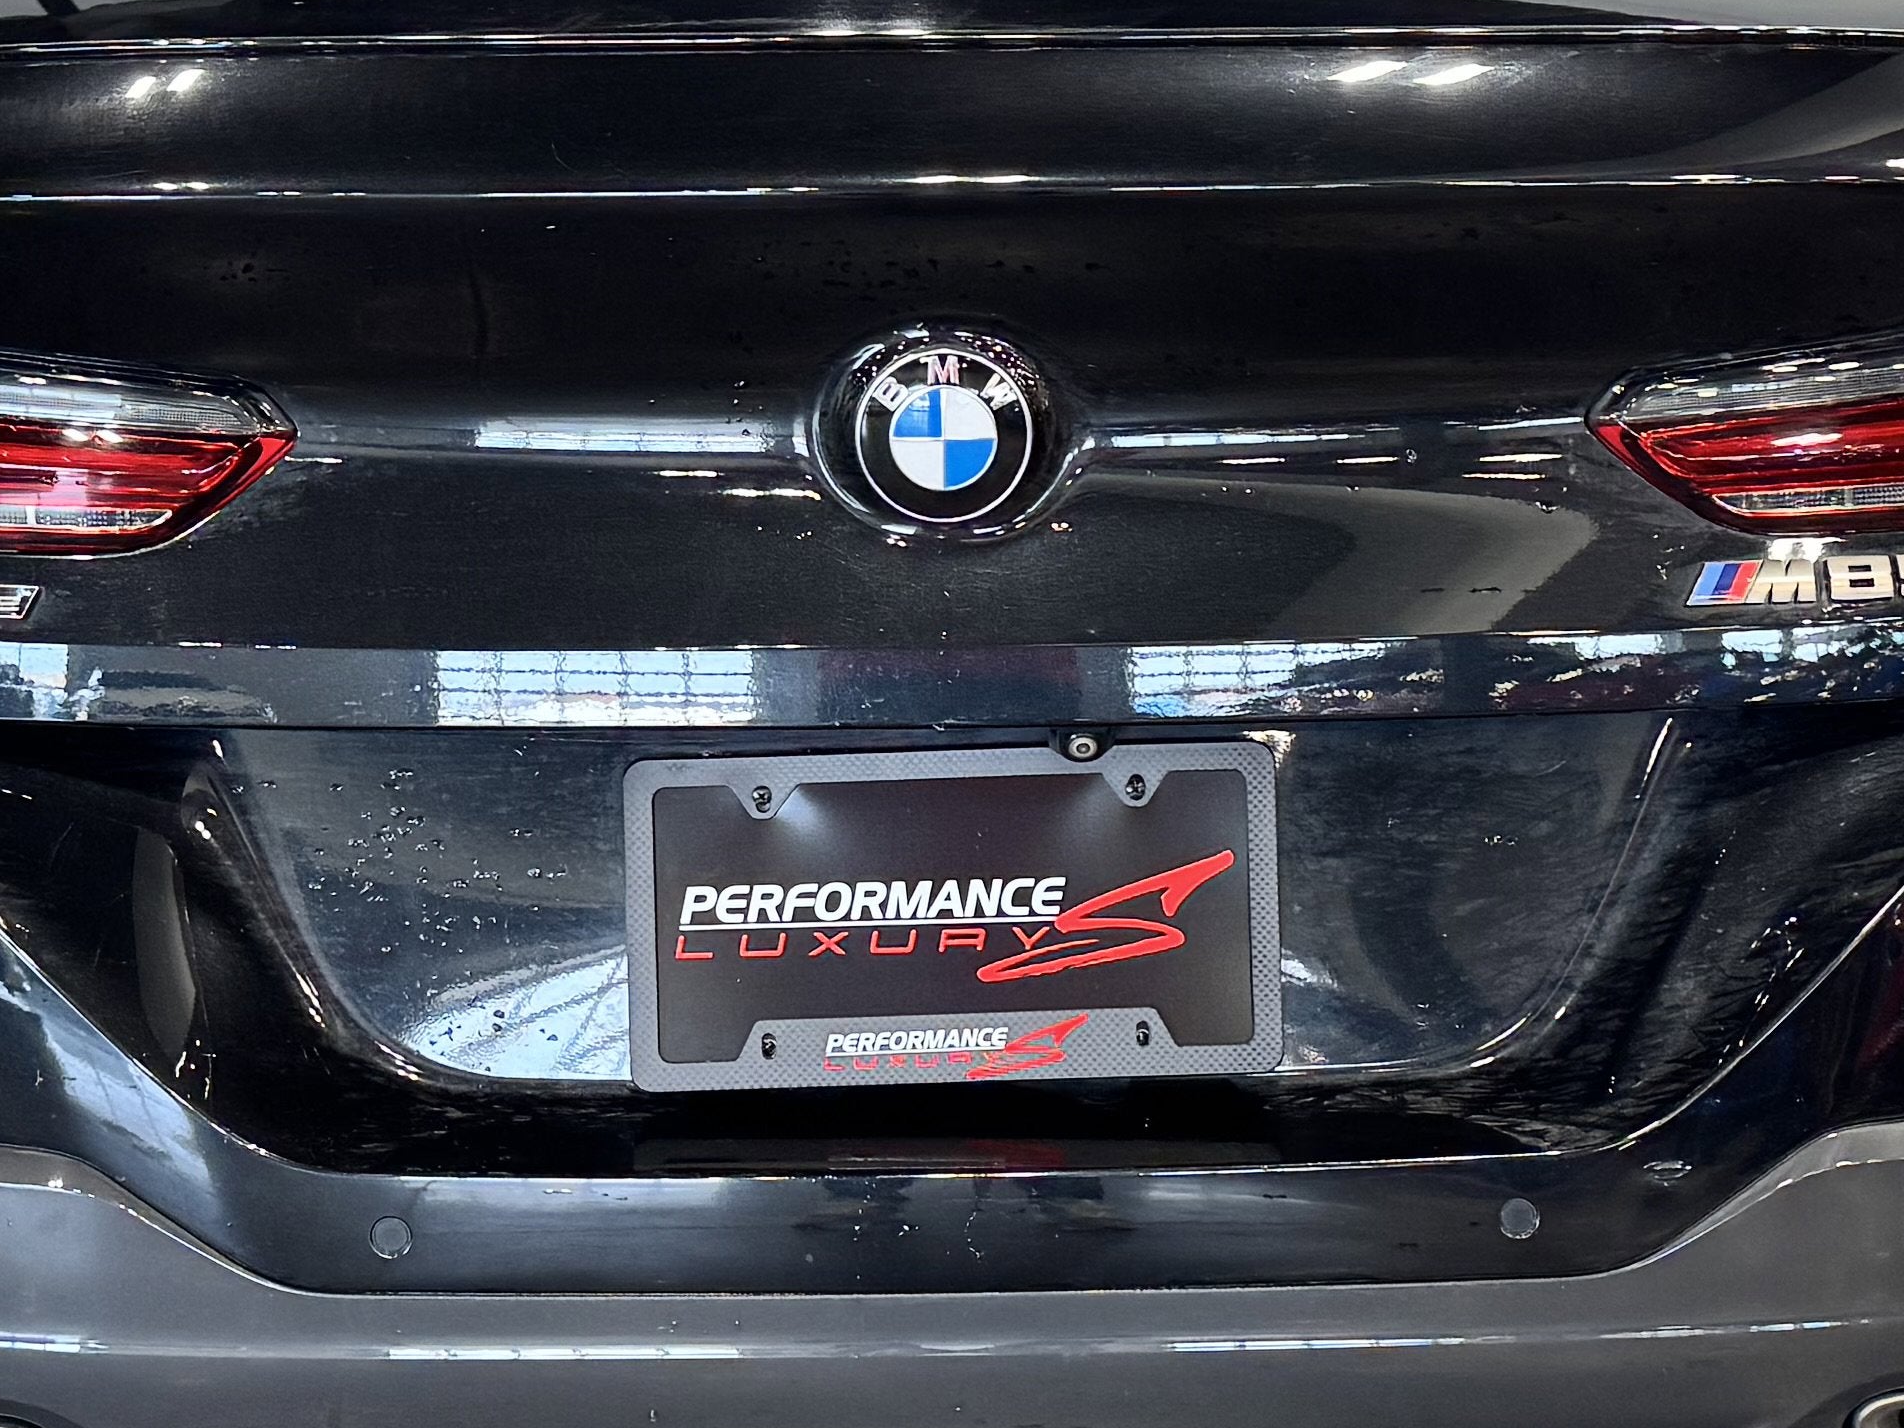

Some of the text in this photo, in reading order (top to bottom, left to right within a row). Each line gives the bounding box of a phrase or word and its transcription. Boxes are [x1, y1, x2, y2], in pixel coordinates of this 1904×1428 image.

[873, 355, 1019, 412] BMW
[679, 876, 1066, 925] PERFORMANCE
[825, 1026, 1009, 1053] PERFORMANCE
